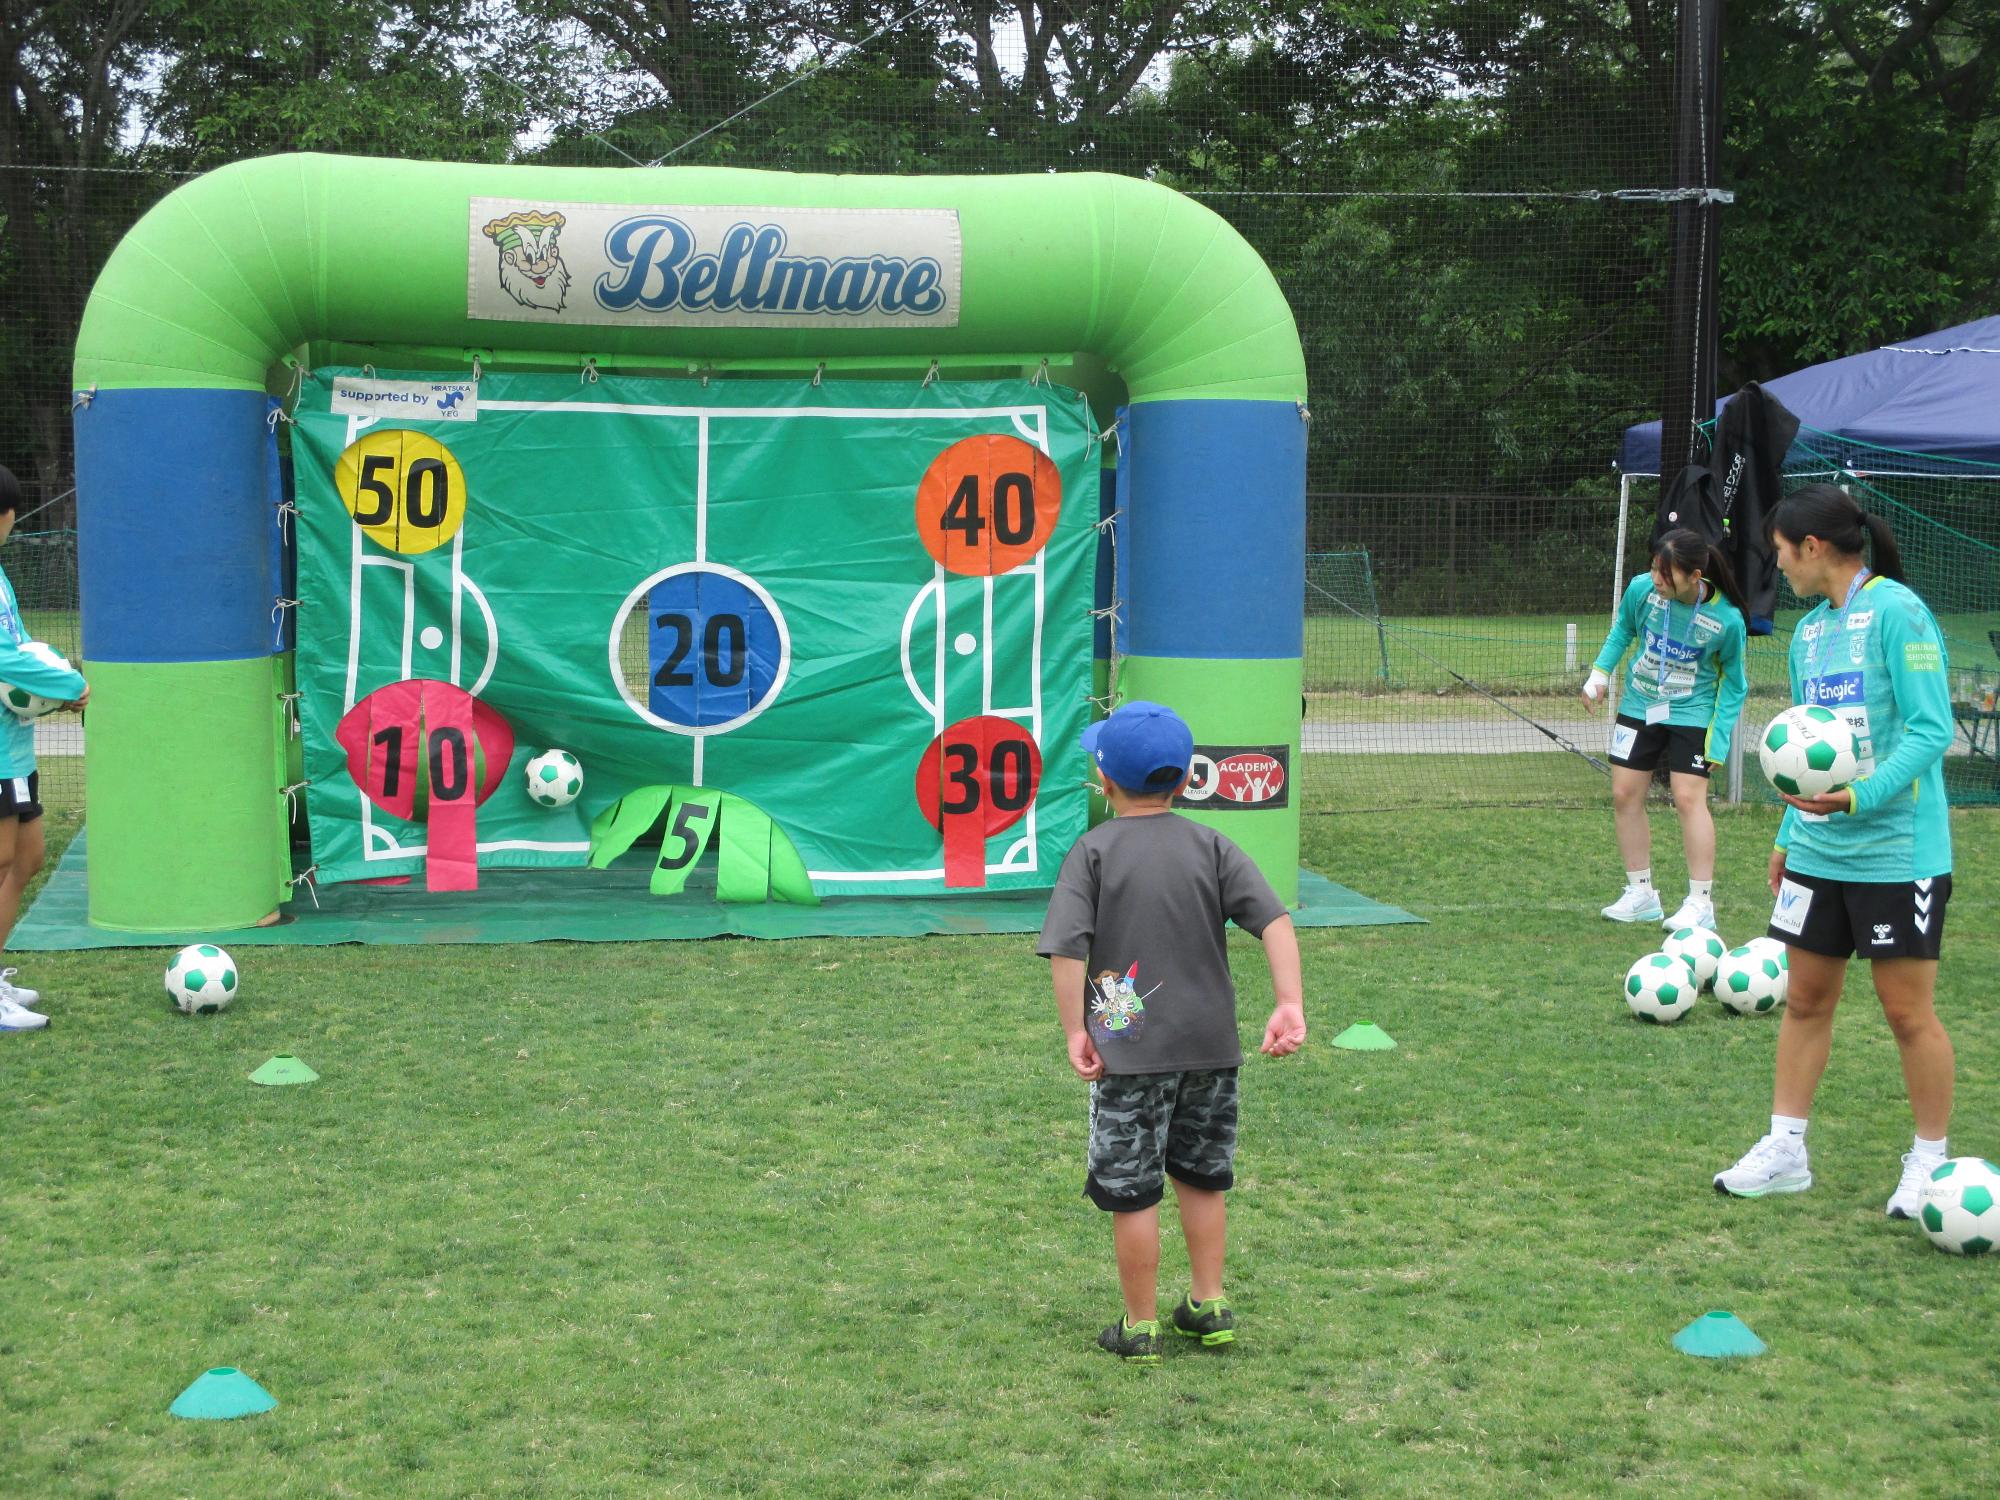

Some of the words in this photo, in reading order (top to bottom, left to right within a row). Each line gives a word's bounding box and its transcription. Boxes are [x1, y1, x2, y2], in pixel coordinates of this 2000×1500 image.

[594, 214, 946, 316] Bellmare
[340, 388, 409, 403] supported
[412, 393, 429, 405] by
[441, 410, 459, 418] YEG
[353, 454, 449, 529] 50
[940, 472, 1035, 547] 40
[653, 612, 747, 688] 20
[1820, 680, 1855, 701] Enagic
[371, 726, 469, 801] 10
[942, 739, 1032, 815] 30
[1219, 762, 1275, 773] ACADEMY
[659, 802, 710, 871] 5
